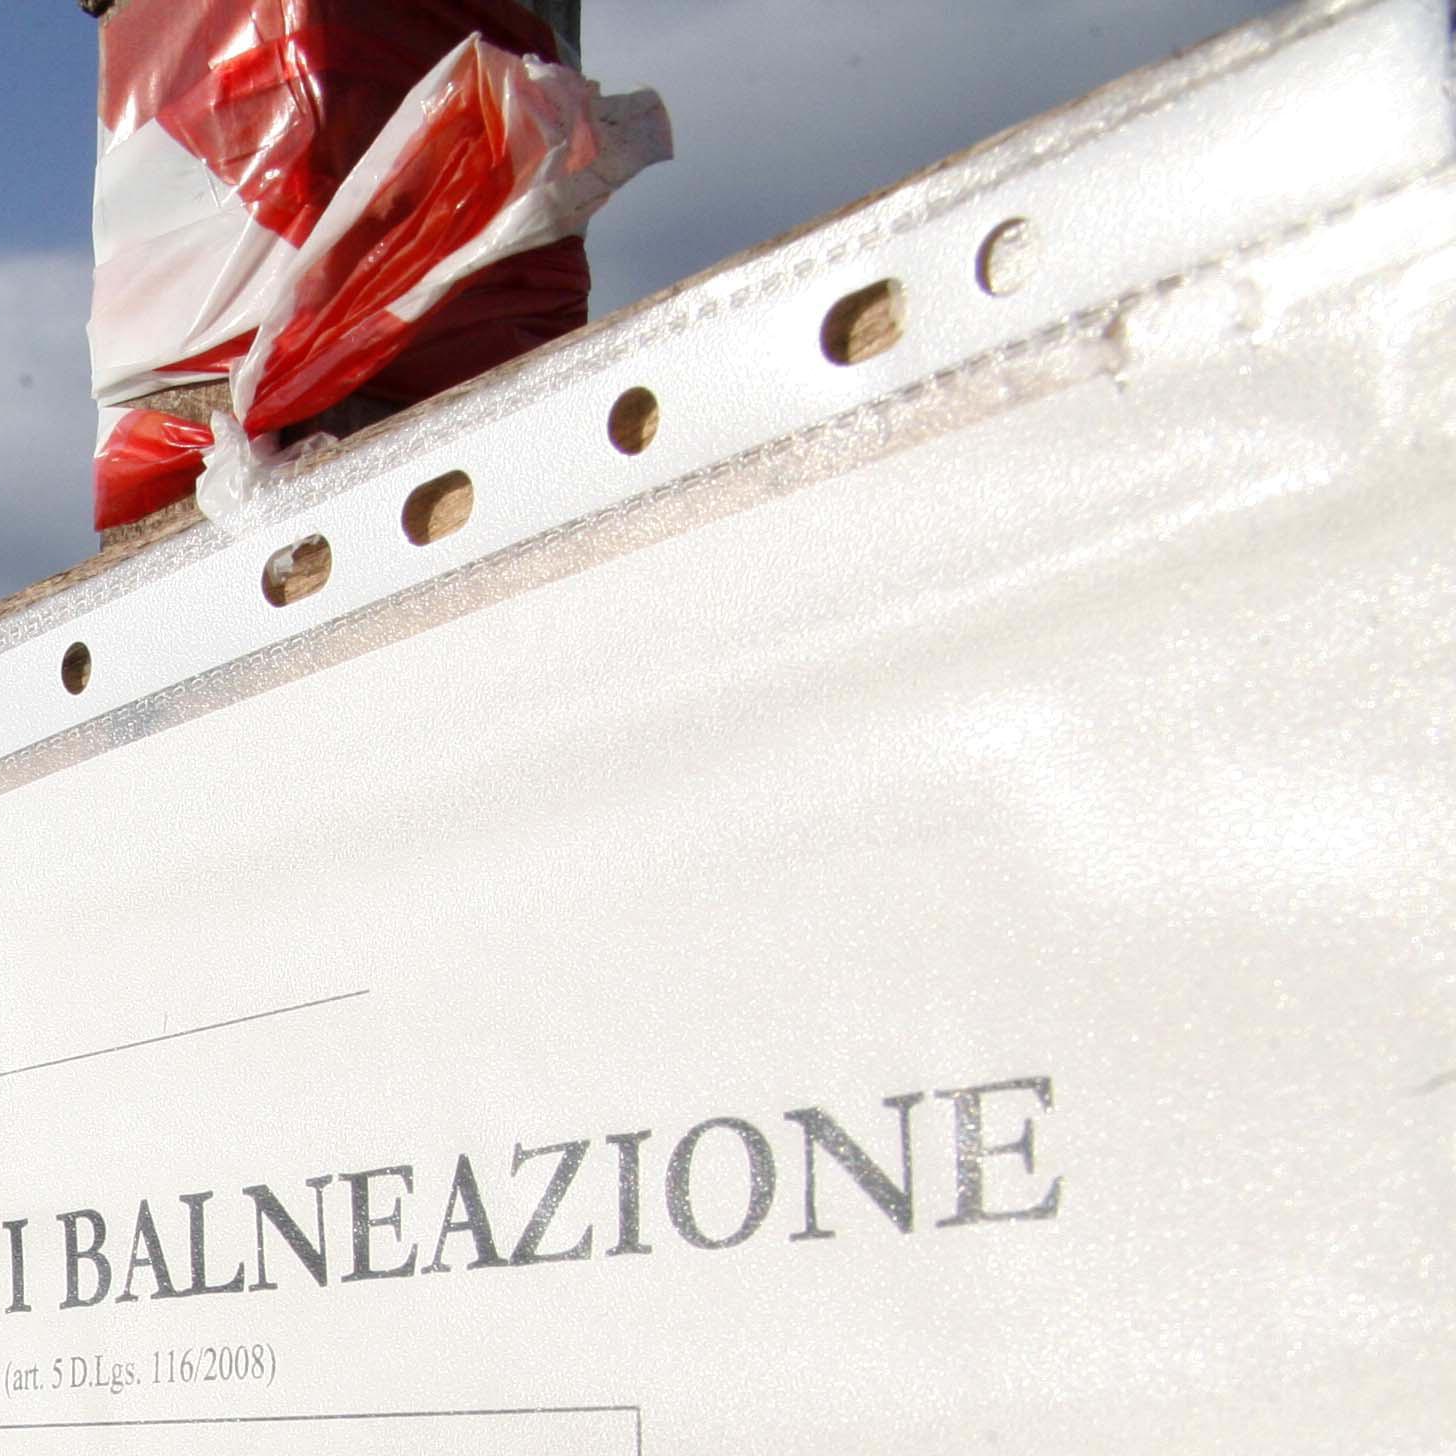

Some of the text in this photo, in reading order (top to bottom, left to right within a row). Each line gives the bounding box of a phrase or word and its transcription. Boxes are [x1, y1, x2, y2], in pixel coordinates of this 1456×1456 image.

[55, 1075, 1065, 1311] BALNEAZIONE
[2, 1342, 278, 1397] (art. 5 D.Lgs. 116/2008)
